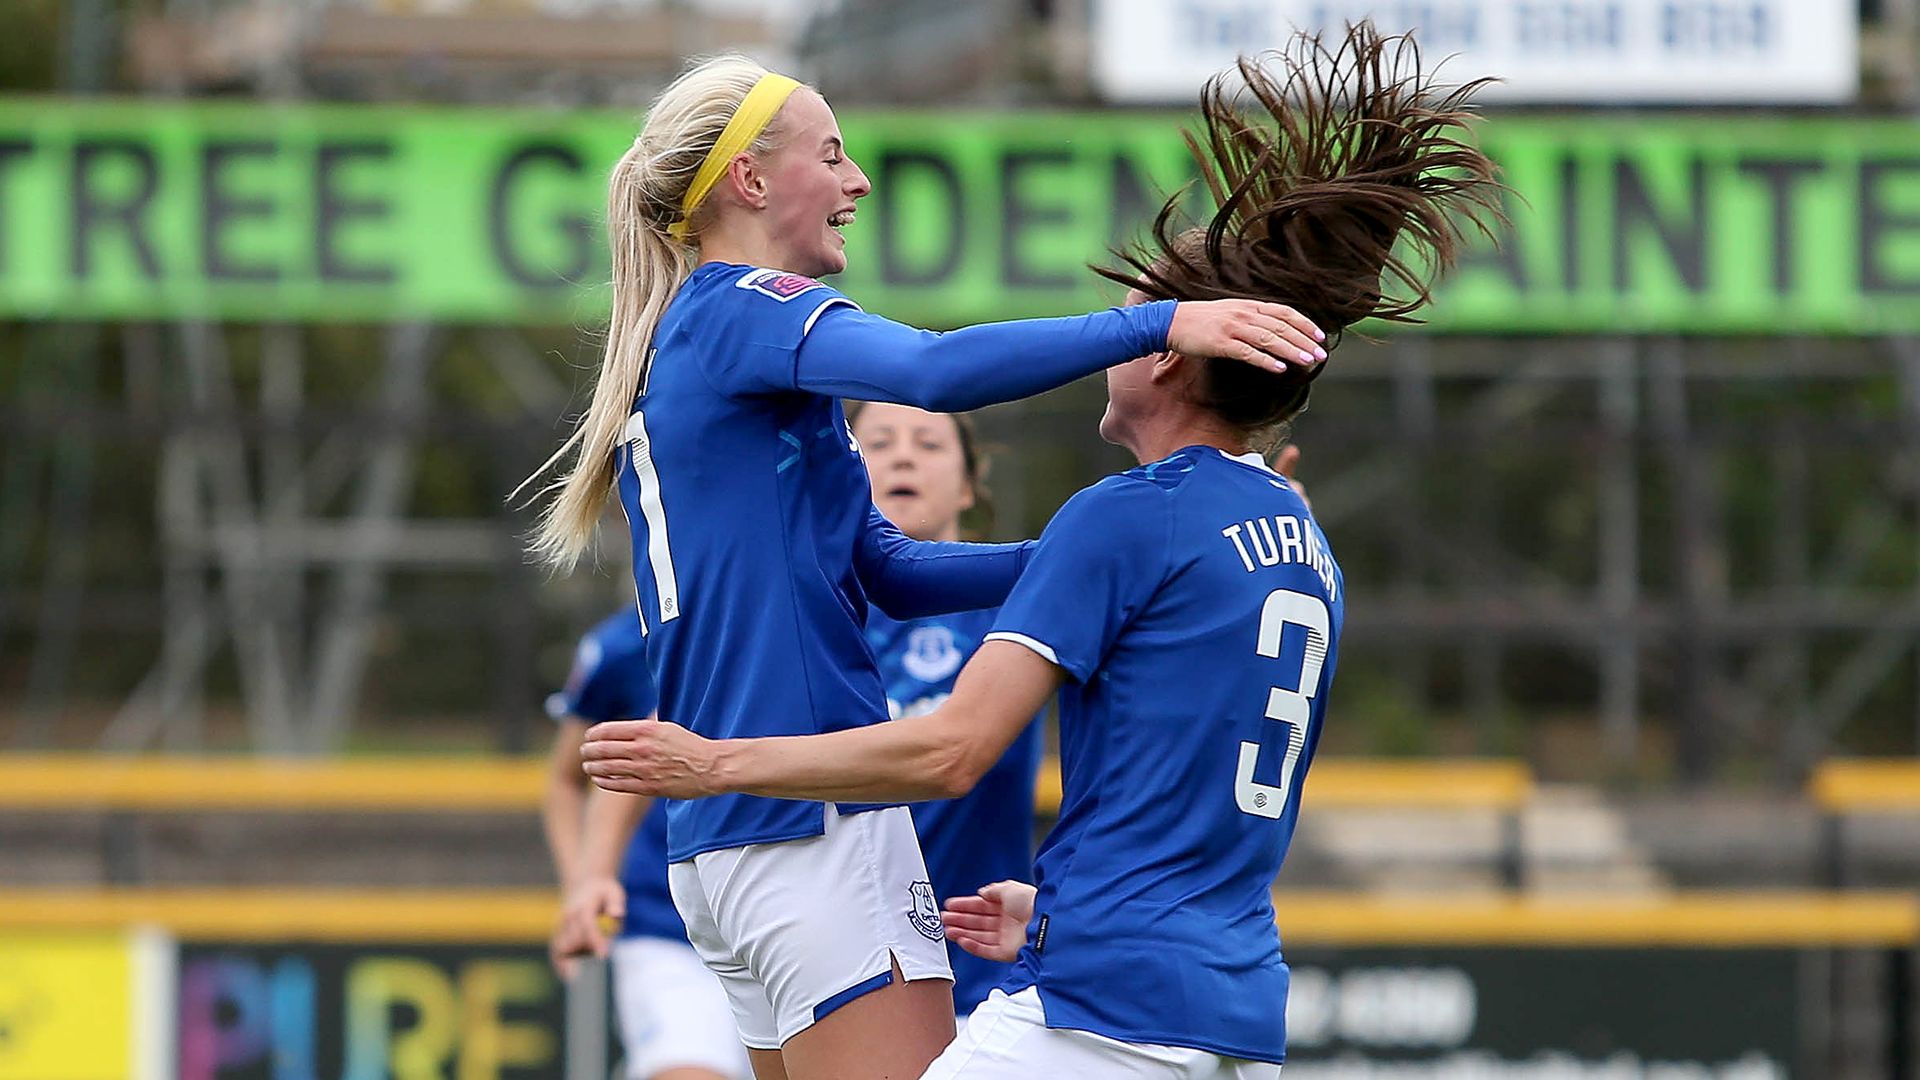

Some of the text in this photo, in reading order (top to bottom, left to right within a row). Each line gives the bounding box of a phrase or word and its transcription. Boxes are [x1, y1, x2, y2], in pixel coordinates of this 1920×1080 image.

[485, 142, 1207, 290] GDEN
[1221, 515, 1336, 602] TURNER
[1234, 589, 1330, 820] 3
